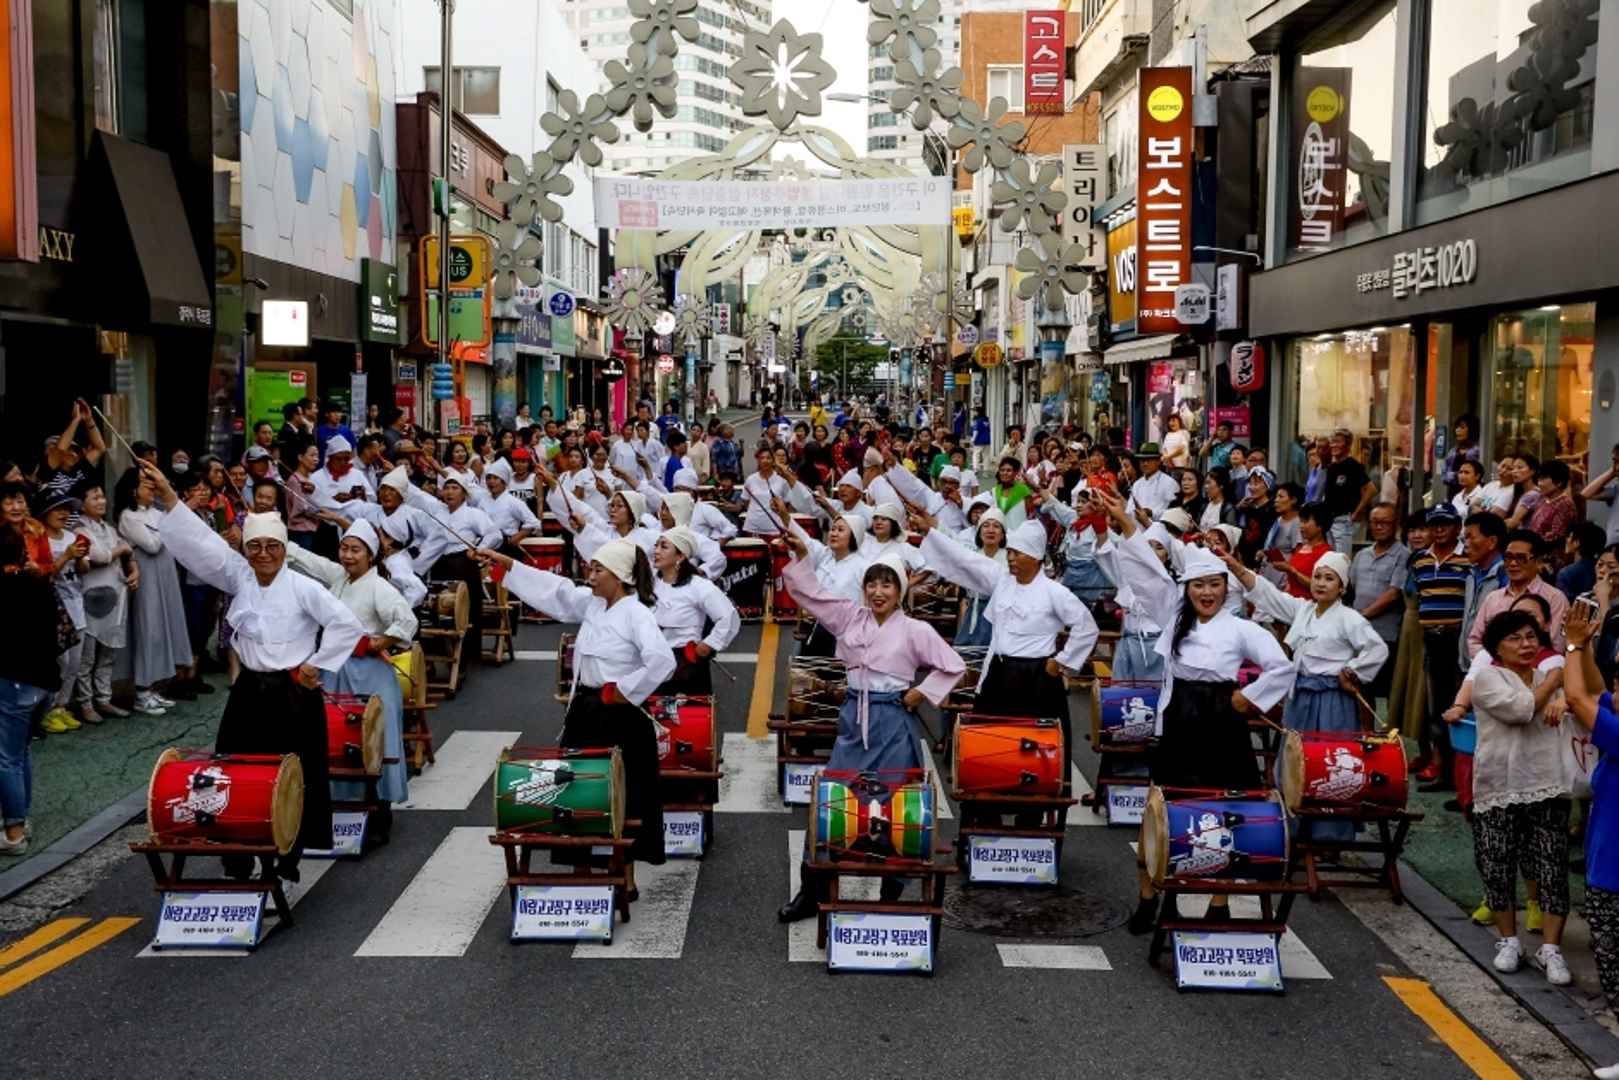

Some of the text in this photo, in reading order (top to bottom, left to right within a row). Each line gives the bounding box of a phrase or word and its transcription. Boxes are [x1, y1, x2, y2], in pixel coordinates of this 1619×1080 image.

[1030, 16, 1059, 95] 고스트
[1145, 136, 1184, 292] 보스트로
[1392, 239, 1477, 298] 플리츠1020
